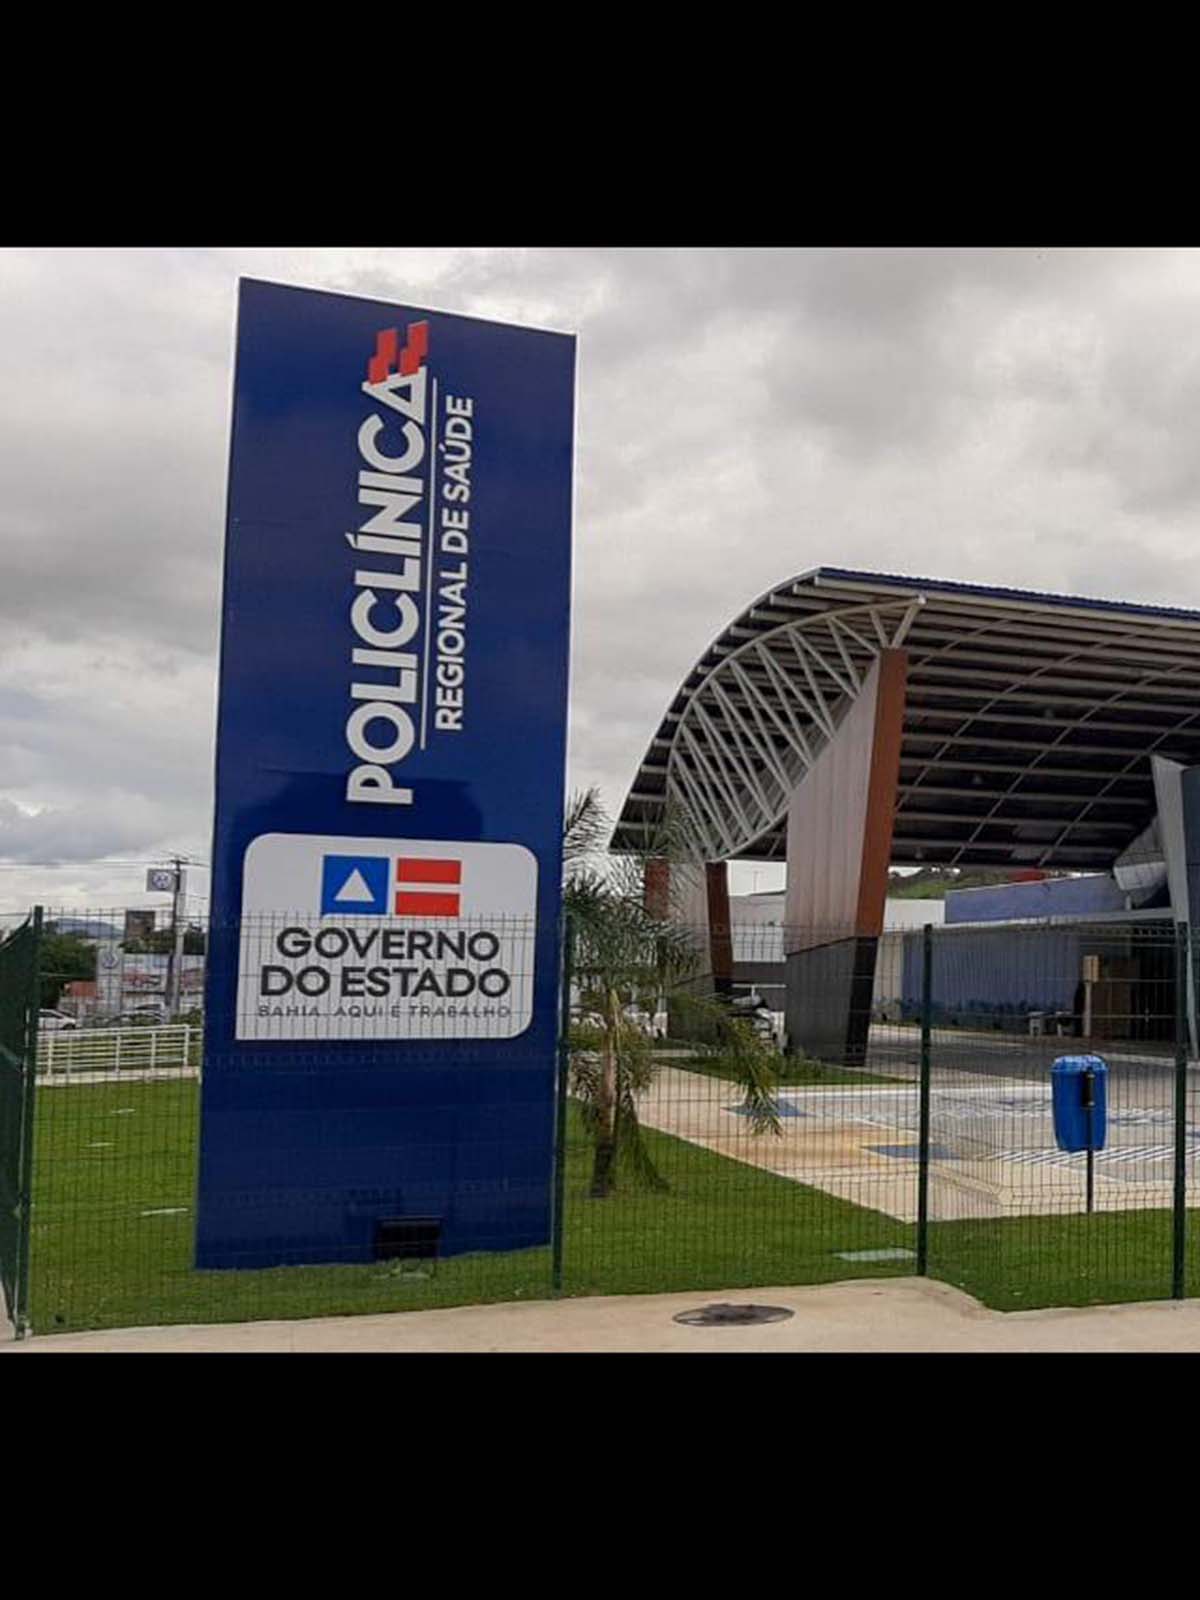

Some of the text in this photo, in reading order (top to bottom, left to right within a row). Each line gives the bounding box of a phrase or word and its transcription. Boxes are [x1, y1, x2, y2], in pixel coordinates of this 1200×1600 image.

[436, 396, 473, 730] REGIONAL DE SAÚDE
[345, 366, 428, 804] POLICLÍNICA
[276, 926, 500, 961] GOVERNO
[260, 965, 511, 998] DO ESTADO
[334, 1005, 383, 1018] AQUI
